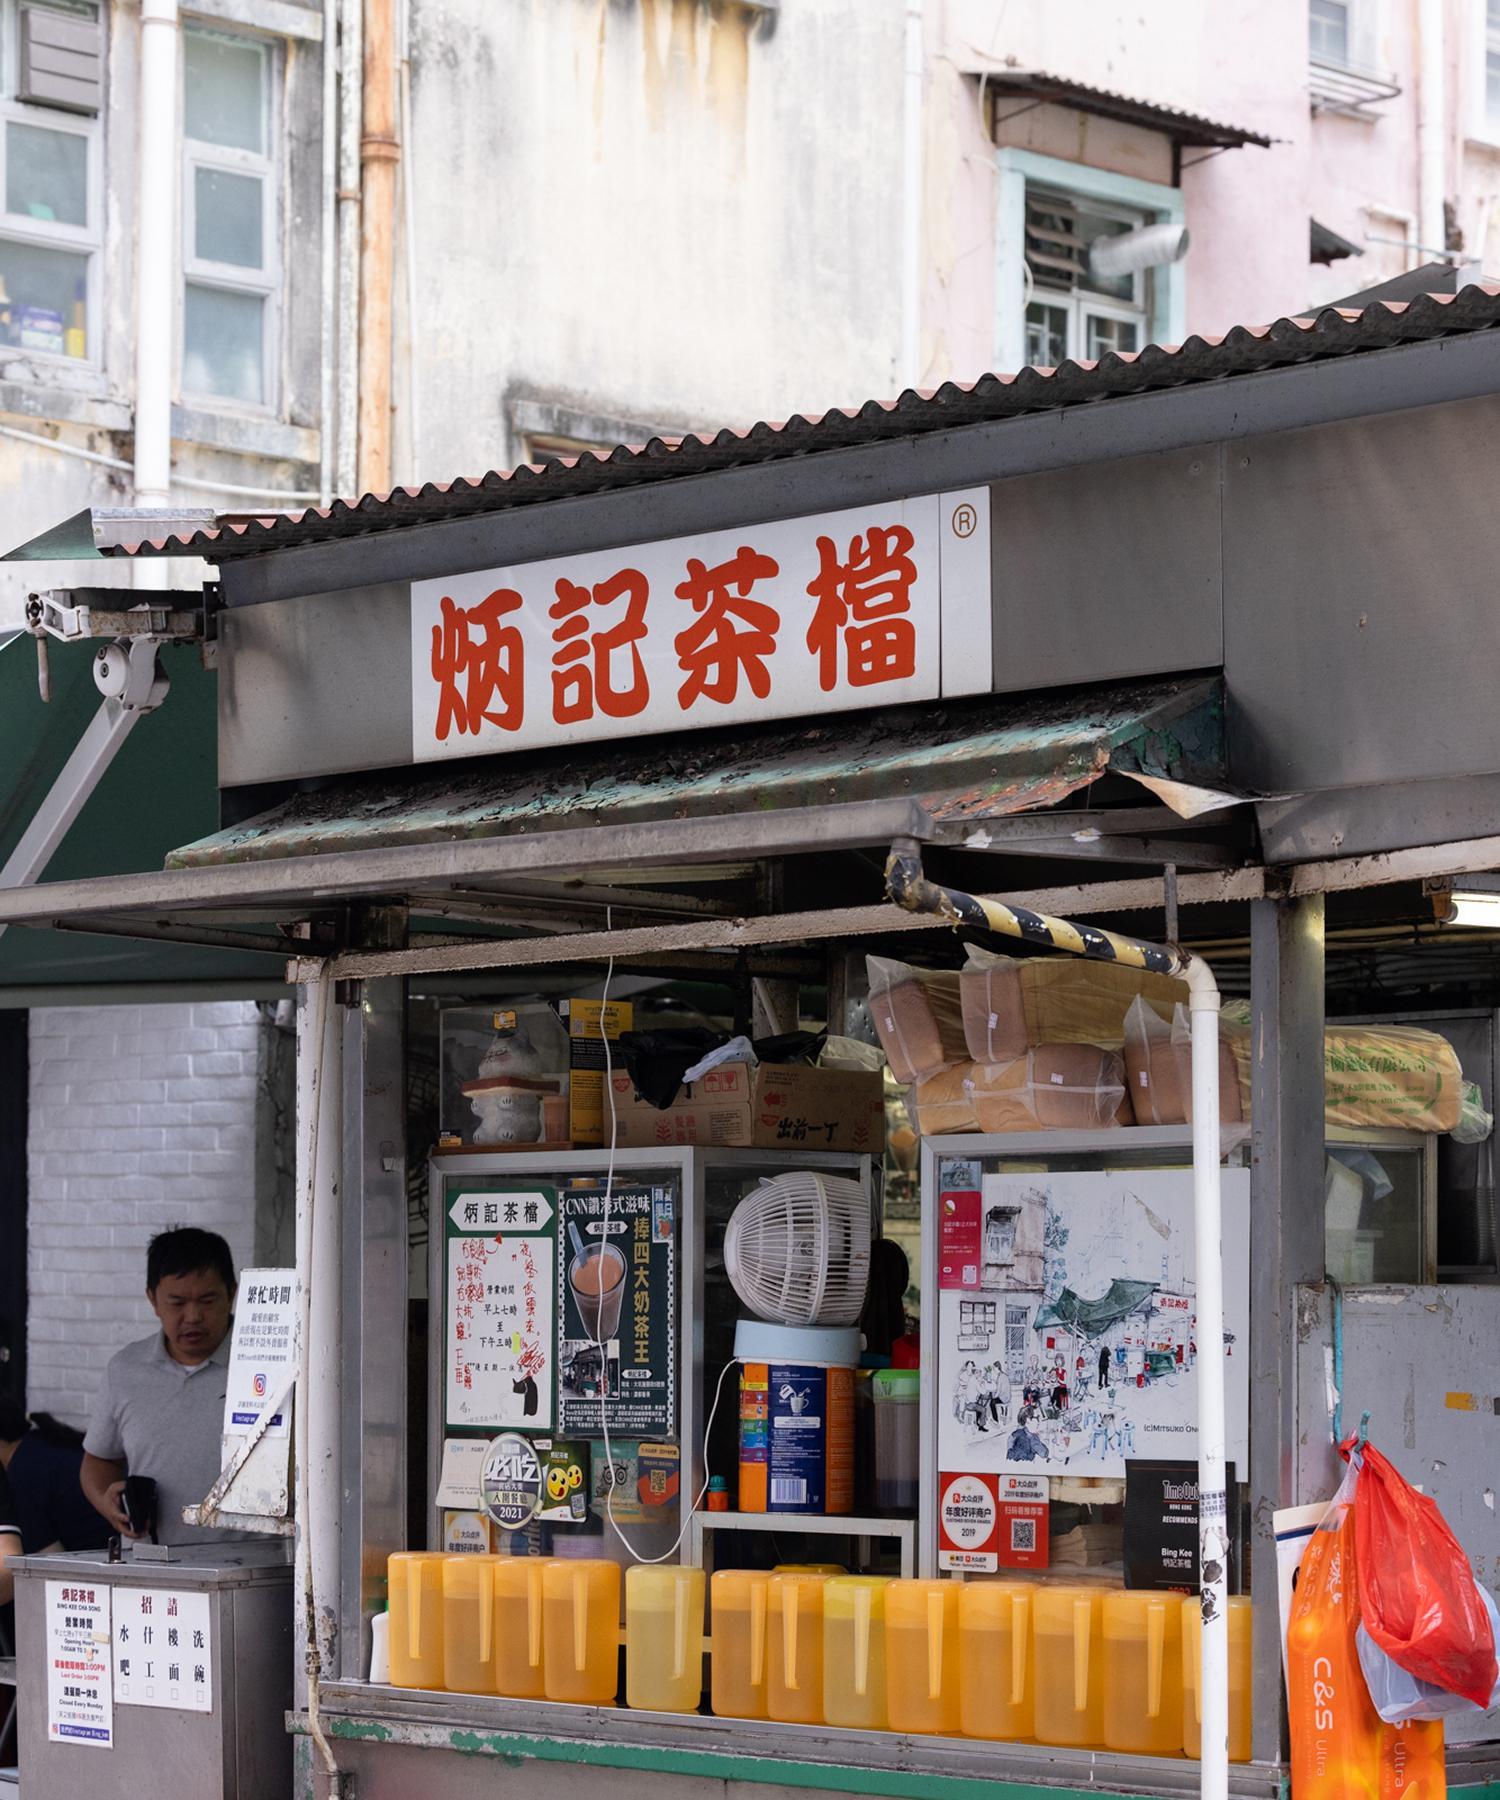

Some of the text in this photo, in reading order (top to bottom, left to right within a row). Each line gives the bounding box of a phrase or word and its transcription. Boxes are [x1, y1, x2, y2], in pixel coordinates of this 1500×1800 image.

[432, 525, 917, 741] 炳記茶檔
[777, 1118, 839, 1142] 出前一丁
[464, 1202, 539, 1224] 炳記茶檔
[247, 1285, 291, 1305] 繁忙時間
[487, 1285, 515, 1296] 營業時間
[634, 1217, 650, 1364] 捧四大奶茶王
[484, 1304, 518, 1316] 早上七時
[479, 1336, 513, 1349] 下午三時
[485, 1454, 542, 1483] 必吃
[961, 1493, 983, 1504] 大众点评
[500, 1506, 523, 1519] 2021
[946, 1506, 992, 1518] 年度好评商户
[1162, 1516, 1198, 1524] RECOMMENDS
[962, 1528, 975, 1538] 2019
[1161, 1548, 1193, 1558] Bing Kee
[61, 1588, 95, 1604] 炳記茶檔
[65, 1616, 93, 1630] 營業時間
[74, 1701, 87, 1709] Every
[87, 1702, 103, 1710] Monday
[1313, 1656, 1335, 1777] C&S Ultra
[1394, 1741, 1406, 1788] Ultra
